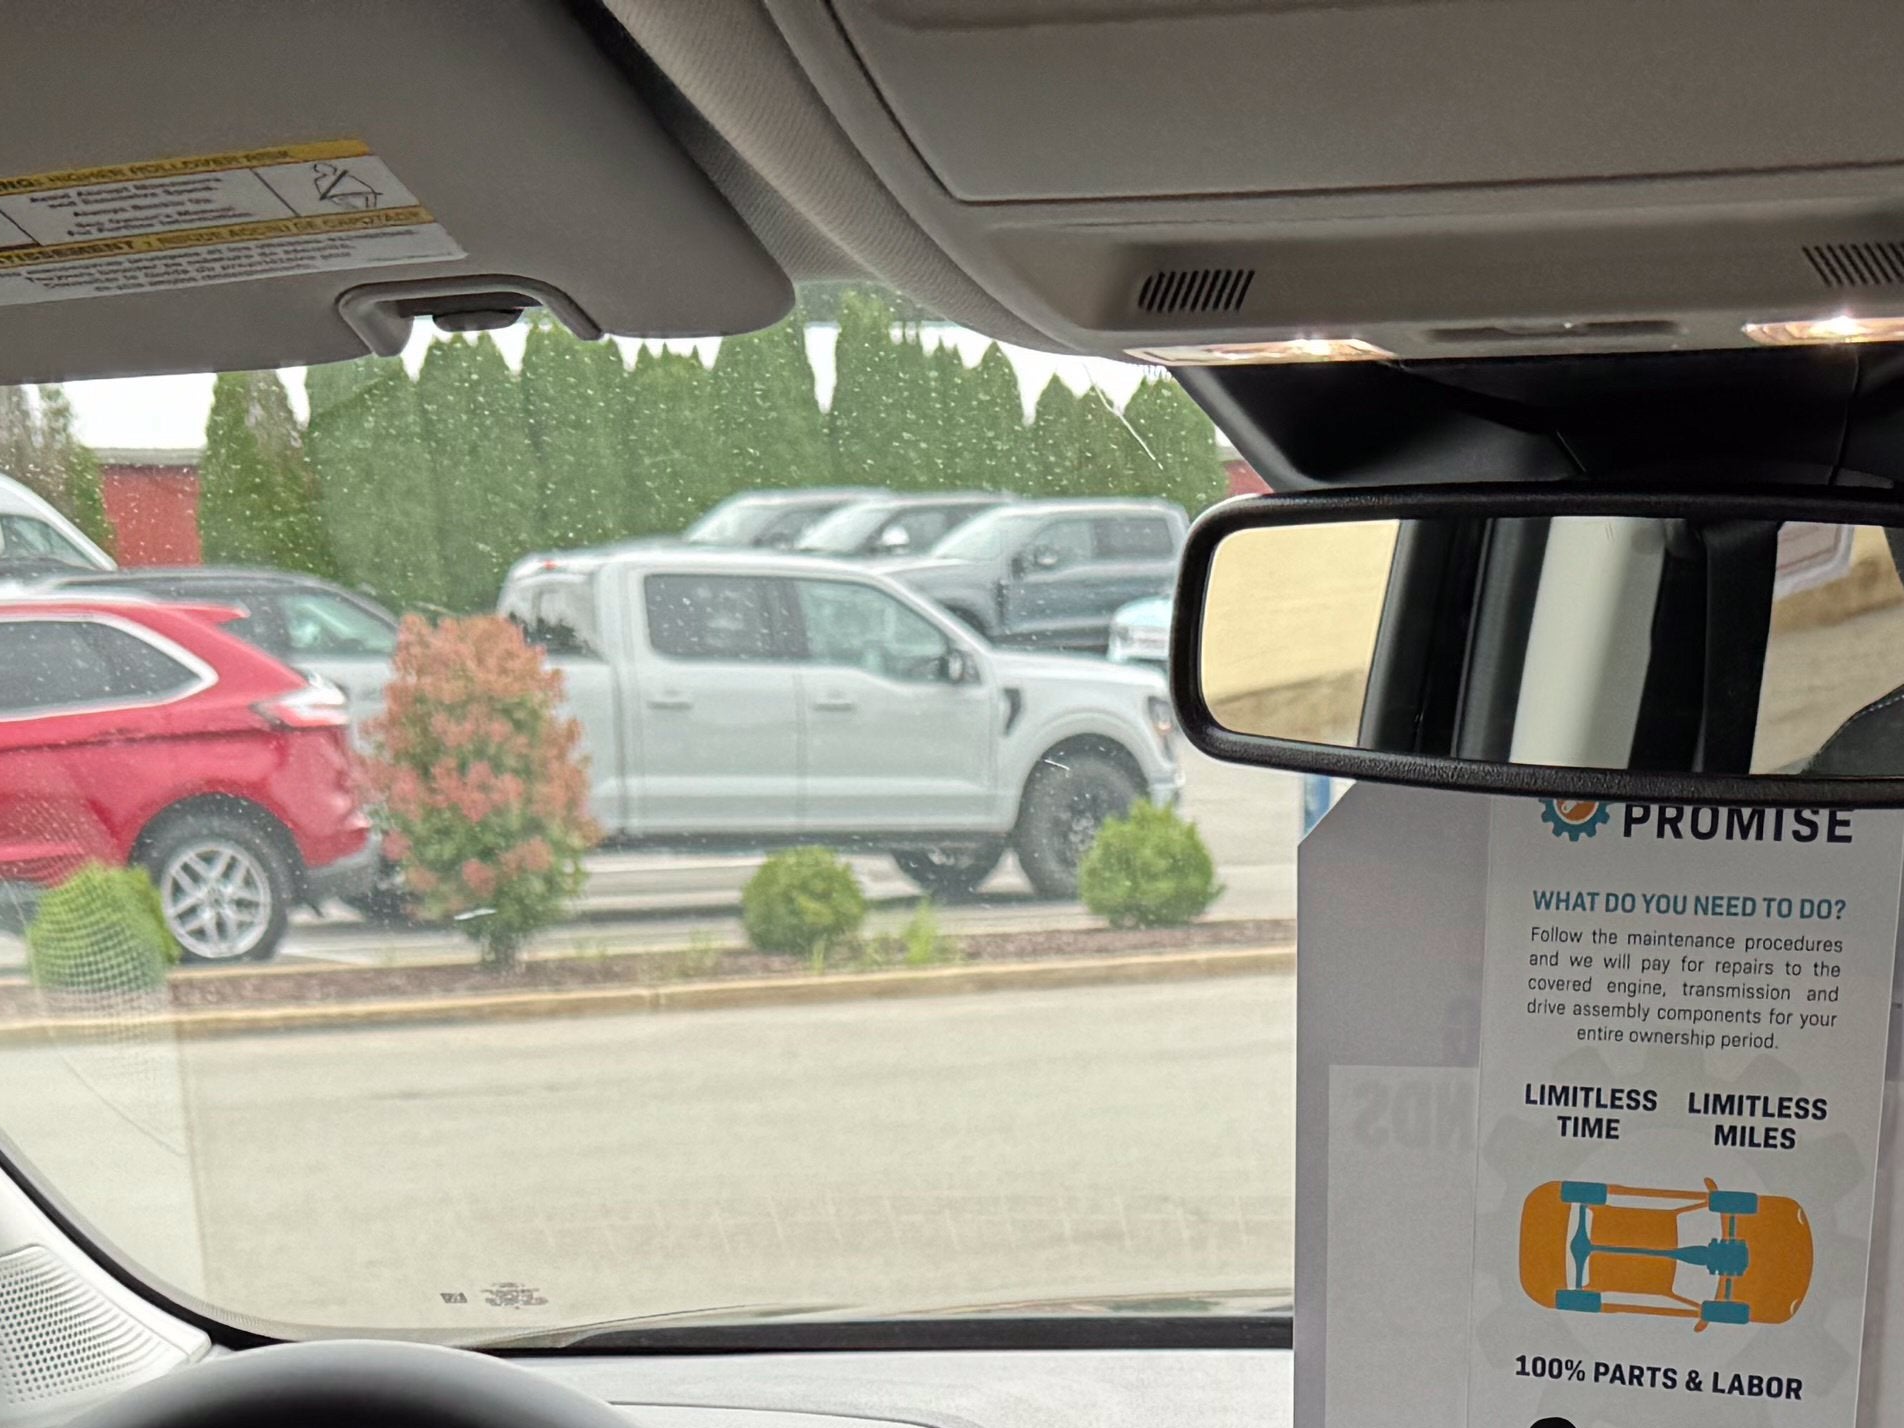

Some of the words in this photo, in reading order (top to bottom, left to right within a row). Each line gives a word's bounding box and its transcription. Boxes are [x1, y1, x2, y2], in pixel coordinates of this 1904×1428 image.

[1623, 802, 1853, 844] PROMISE
[1533, 890, 1599, 911] WHAT
[1604, 892, 1635, 913] DO
[1642, 894, 1687, 915] YOU
[1694, 896, 1756, 917] NEED
[1762, 898, 1792, 918] TO
[1800, 899, 1846, 920] DO?
[1531, 927, 1582, 943] Follow
[1592, 929, 1617, 945] the
[1627, 932, 1735, 949] maintenance
[1745, 935, 1843, 953] procedures
[1529, 952, 1559, 967] and
[1569, 955, 1593, 968] we
[1603, 954, 1630, 970] will
[1641, 959, 1670, 974] pay
[1681, 956, 1704, 972] for
[1715, 961, 1774, 977] repairs
[1785, 961, 1801, 976] to
[1813, 961, 1841, 977] the
[1528, 977, 1591, 993] covered
[1607, 980, 1666, 998] engine,
[1682, 982, 1790, 1001] transmission
[1806, 986, 1839, 1002] and
[1527, 998, 1565, 1015] drive
[1573, 1002, 1650, 1021] assembly
[1657, 1007, 1761, 1025] components
[1769, 1010, 1793, 1026] for
[1799, 1014, 1837, 1029] your
[1577, 1027, 1623, 1042] entire
[1629, 1029, 1714, 1048] ownership
[1721, 1032, 1778, 1050] period.
[1524, 1083, 1658, 1112] LIMITLESS
[1688, 1091, 1828, 1121] LIMITLESS
[1557, 1115, 1621, 1140] TIME
[1714, 1124, 1796, 1150] MILES
[1515, 1355, 1585, 1382] 100%
[1593, 1361, 1678, 1390] PARTS
[1684, 1369, 1703, 1393] &
[1712, 1371, 1803, 1400] LABOR
